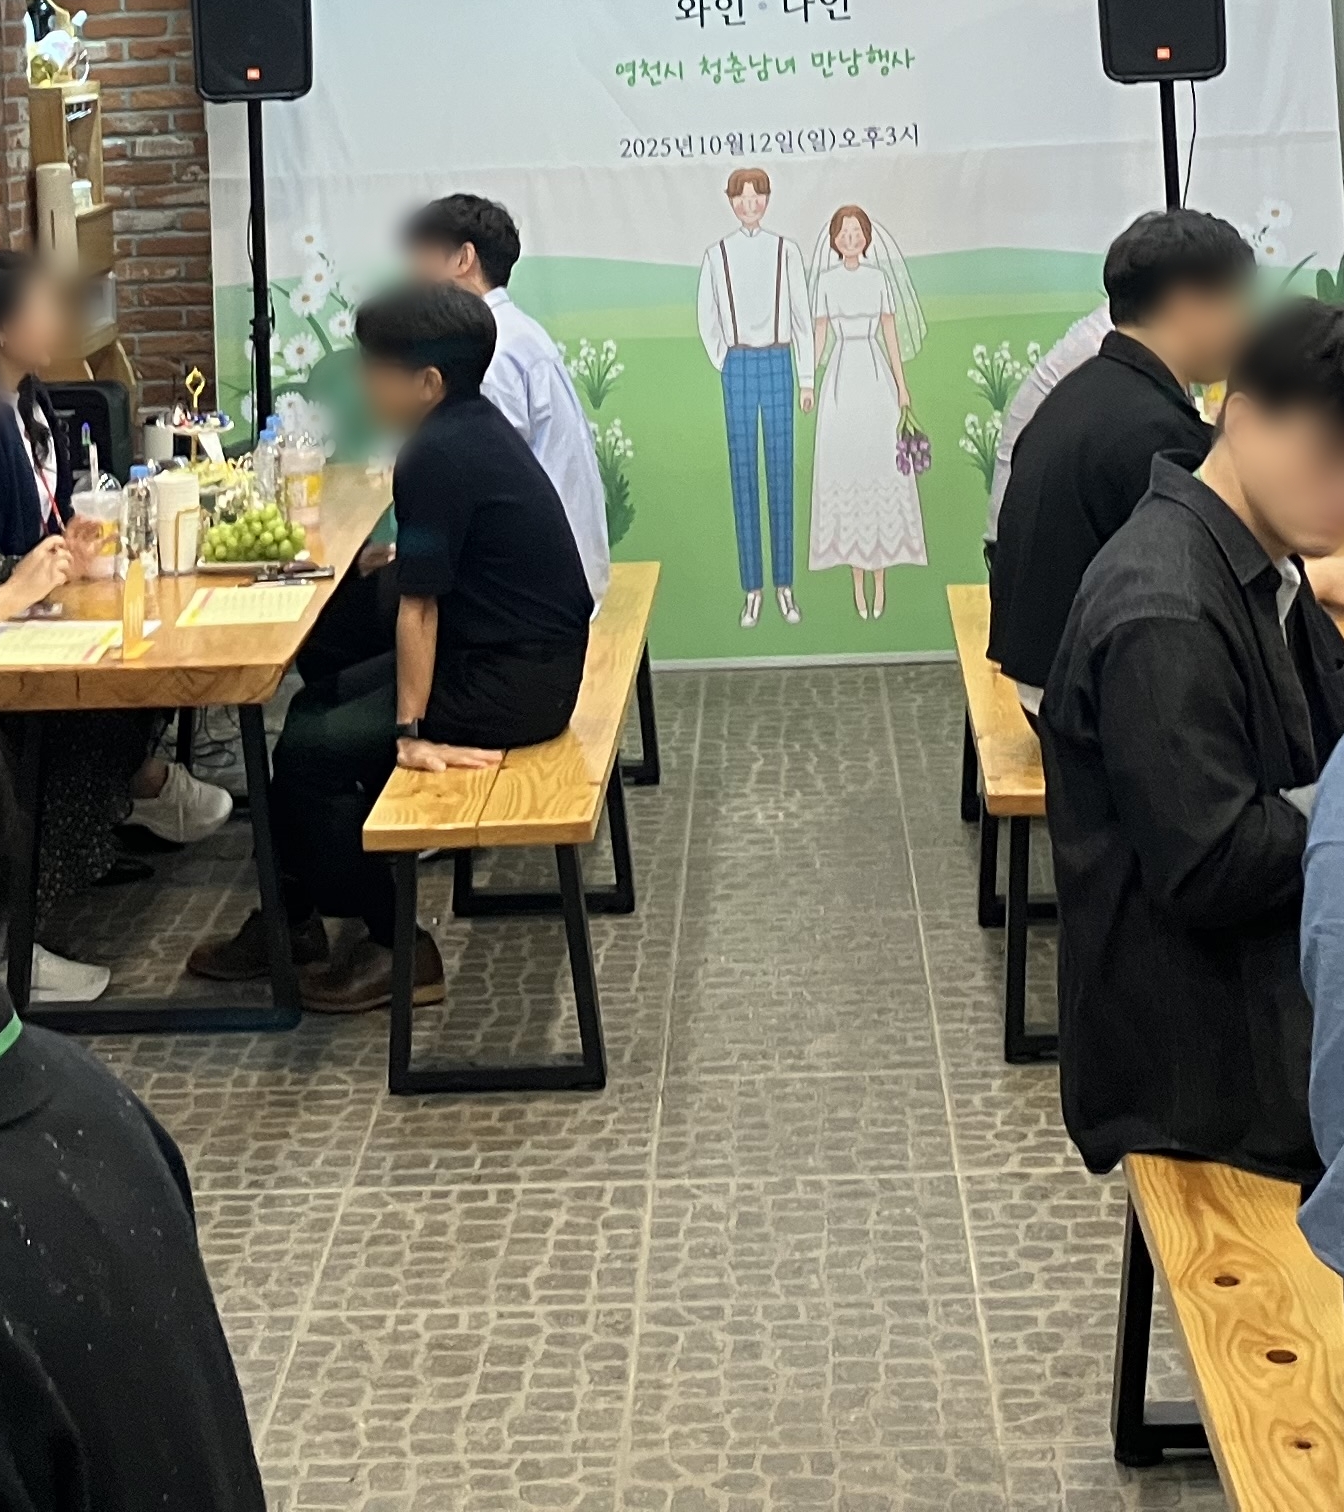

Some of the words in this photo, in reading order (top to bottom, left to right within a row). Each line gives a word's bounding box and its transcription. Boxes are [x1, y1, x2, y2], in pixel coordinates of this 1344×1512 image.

[615, 54, 685, 88] 영천시
[699, 51, 797, 85] 청춘남녀
[810, 43, 916, 81] 만남행사
[618, 122, 920, 159] 2025년10월12일(일)오후3시
